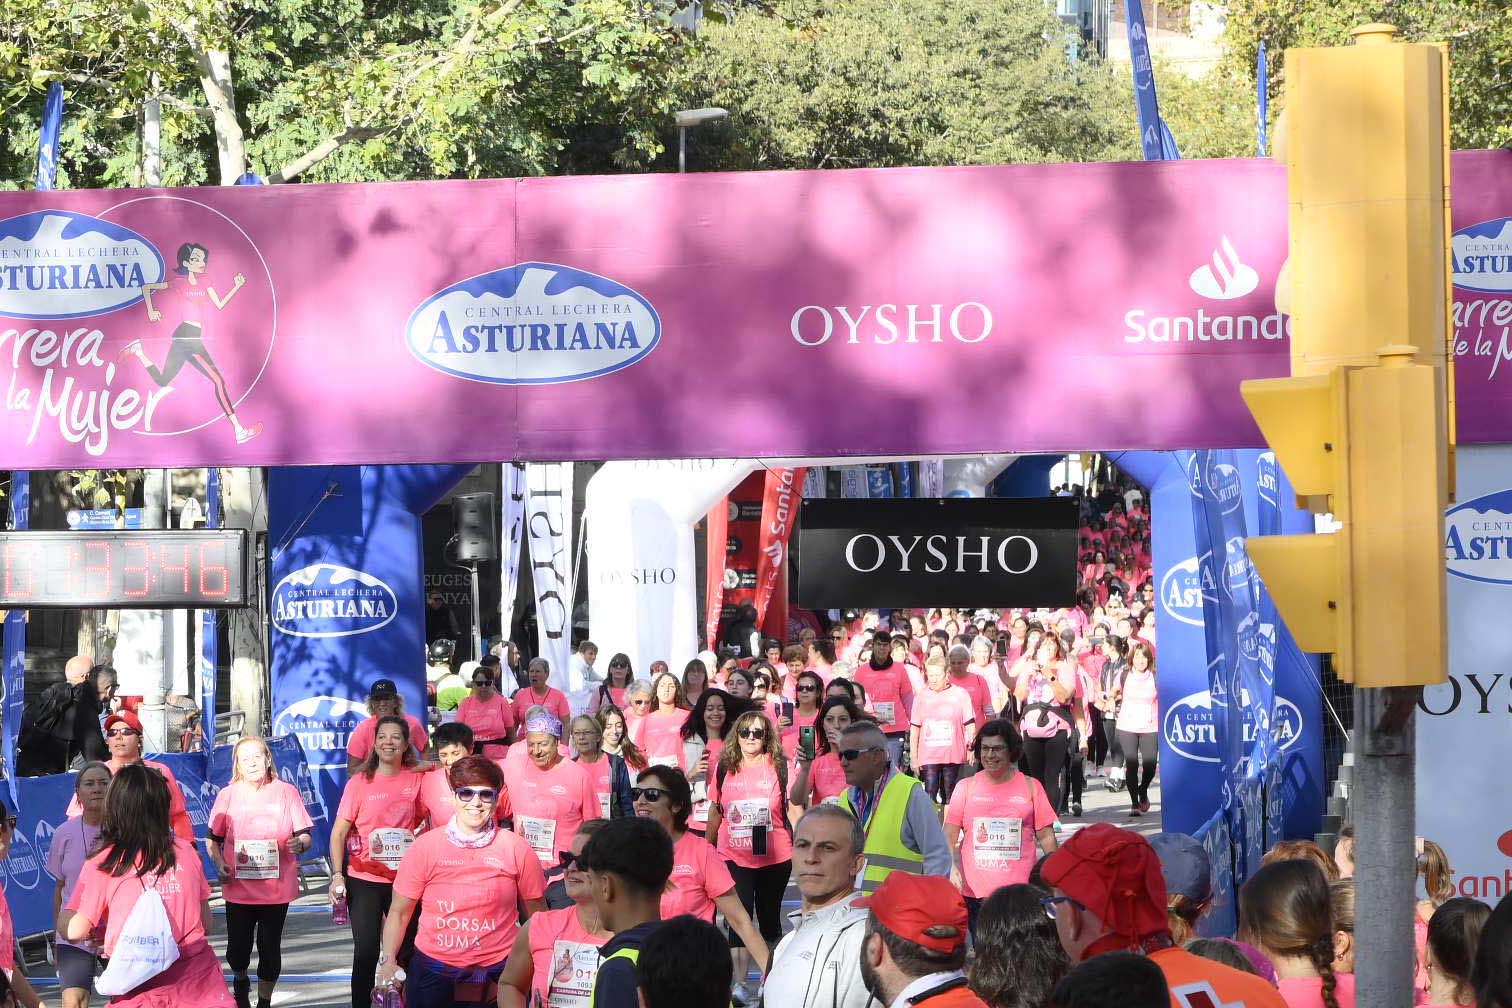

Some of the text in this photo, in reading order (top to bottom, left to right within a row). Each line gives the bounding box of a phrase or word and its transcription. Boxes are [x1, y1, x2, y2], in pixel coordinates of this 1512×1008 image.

[68, 247, 140, 258] LECHERA
[464, 303, 634, 319] CENTRAL LECHERA
[425, 310, 641, 354] ASTURIANA
[790, 302, 993, 346] OYSHO
[1475, 332, 1492, 357] la
[7, 372, 31, 411] la
[26, 362, 175, 457] Mujer
[845, 533, 1039, 575] OYSHO
[600, 567, 676, 584] OYSHO
[288, 588, 383, 598] CENTRAL LECHERA
[276, 593, 388, 621] ASTURIANA
[1418, 673, 1512, 716] OY
[289, 720, 329, 729] CENTRAL
[729, 838, 753, 848] SUM
[436, 900, 455, 913] TU
[575, 968, 595, 980] 01
